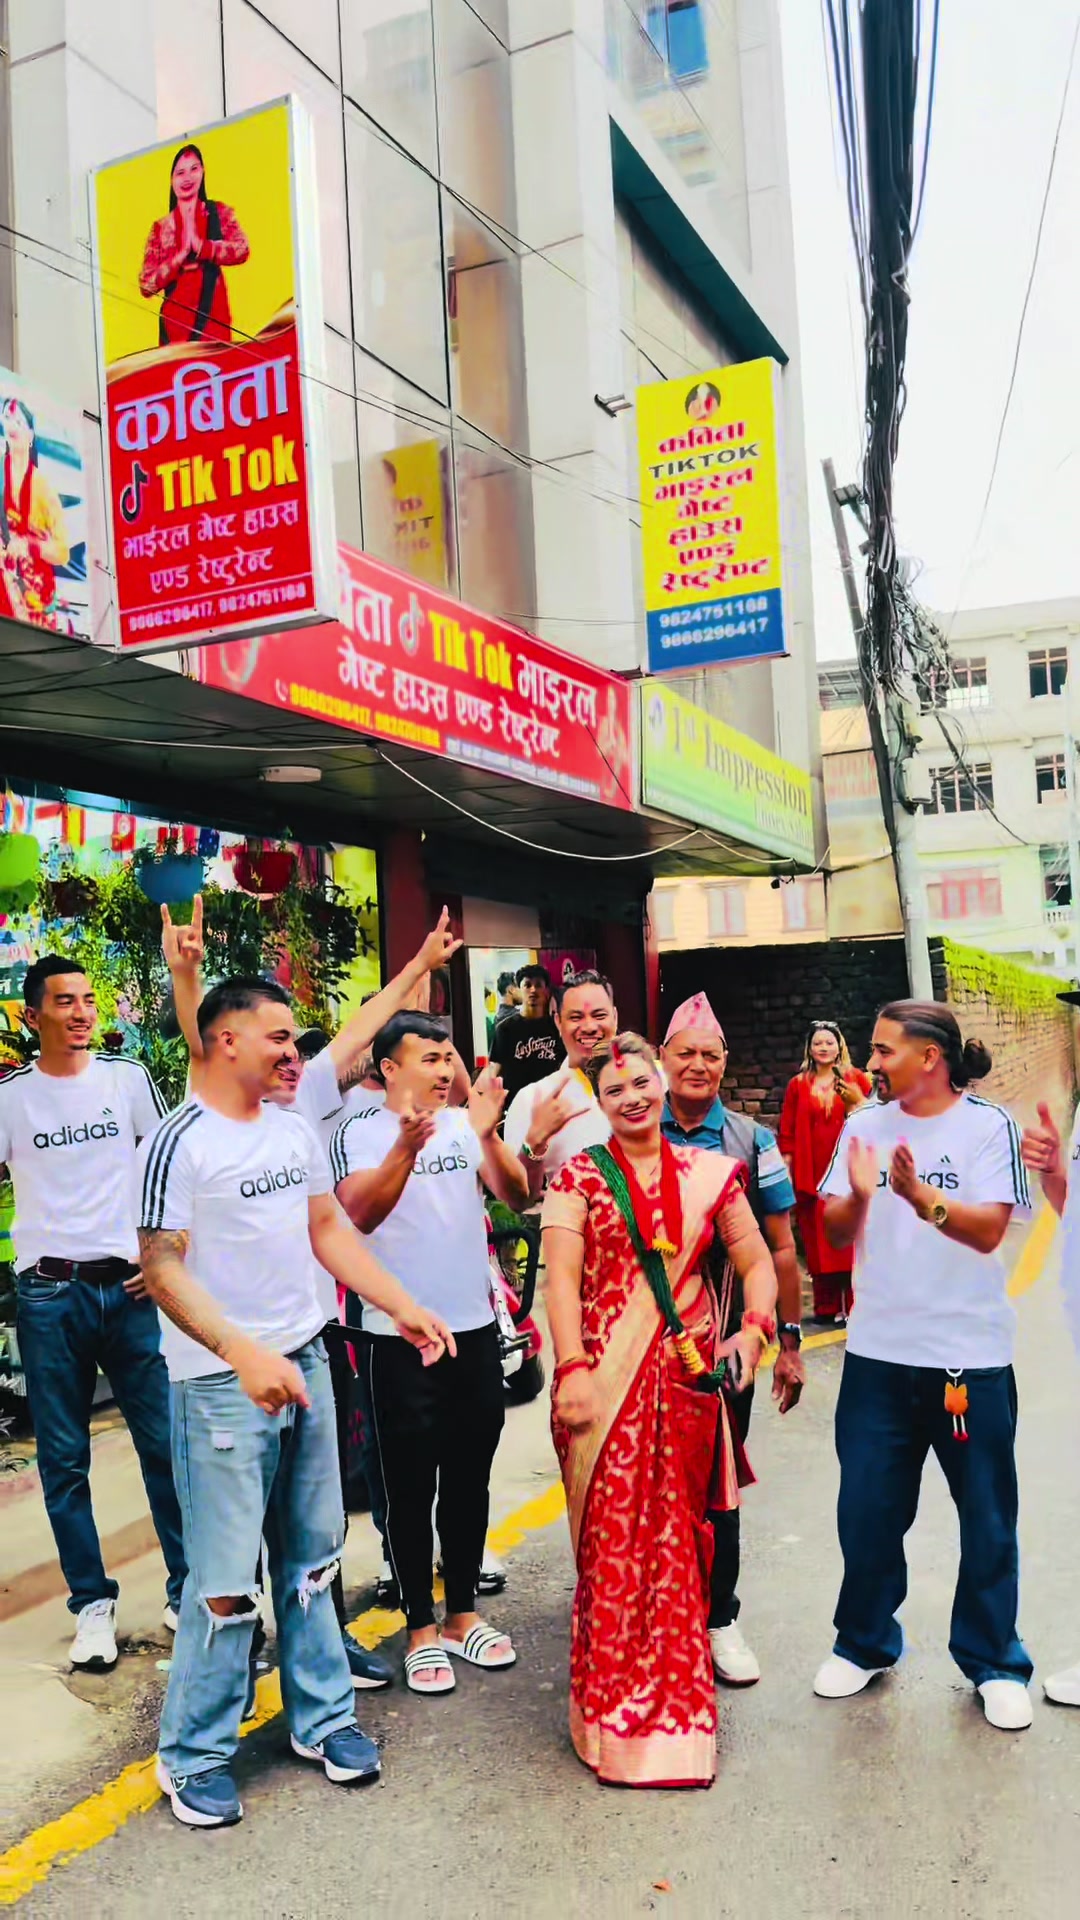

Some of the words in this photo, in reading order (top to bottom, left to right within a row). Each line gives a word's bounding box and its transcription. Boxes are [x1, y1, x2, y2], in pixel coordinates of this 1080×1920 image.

[114, 354, 292, 452] कबिता
[156, 455, 217, 513] Tik
[222, 433, 300, 497] Tok
[648, 442, 759, 479] TIKTOK
[243, 498, 299, 536] हाउस
[150, 564, 191, 594] एण्ड
[428, 610, 469, 674] Tik
[469, 628, 514, 692] Tok
[391, 667, 449, 722] हाउस
[453, 688, 494, 734] एण्ड
[705, 721, 808, 817] Impression
[33, 1121, 119, 1149] adidas
